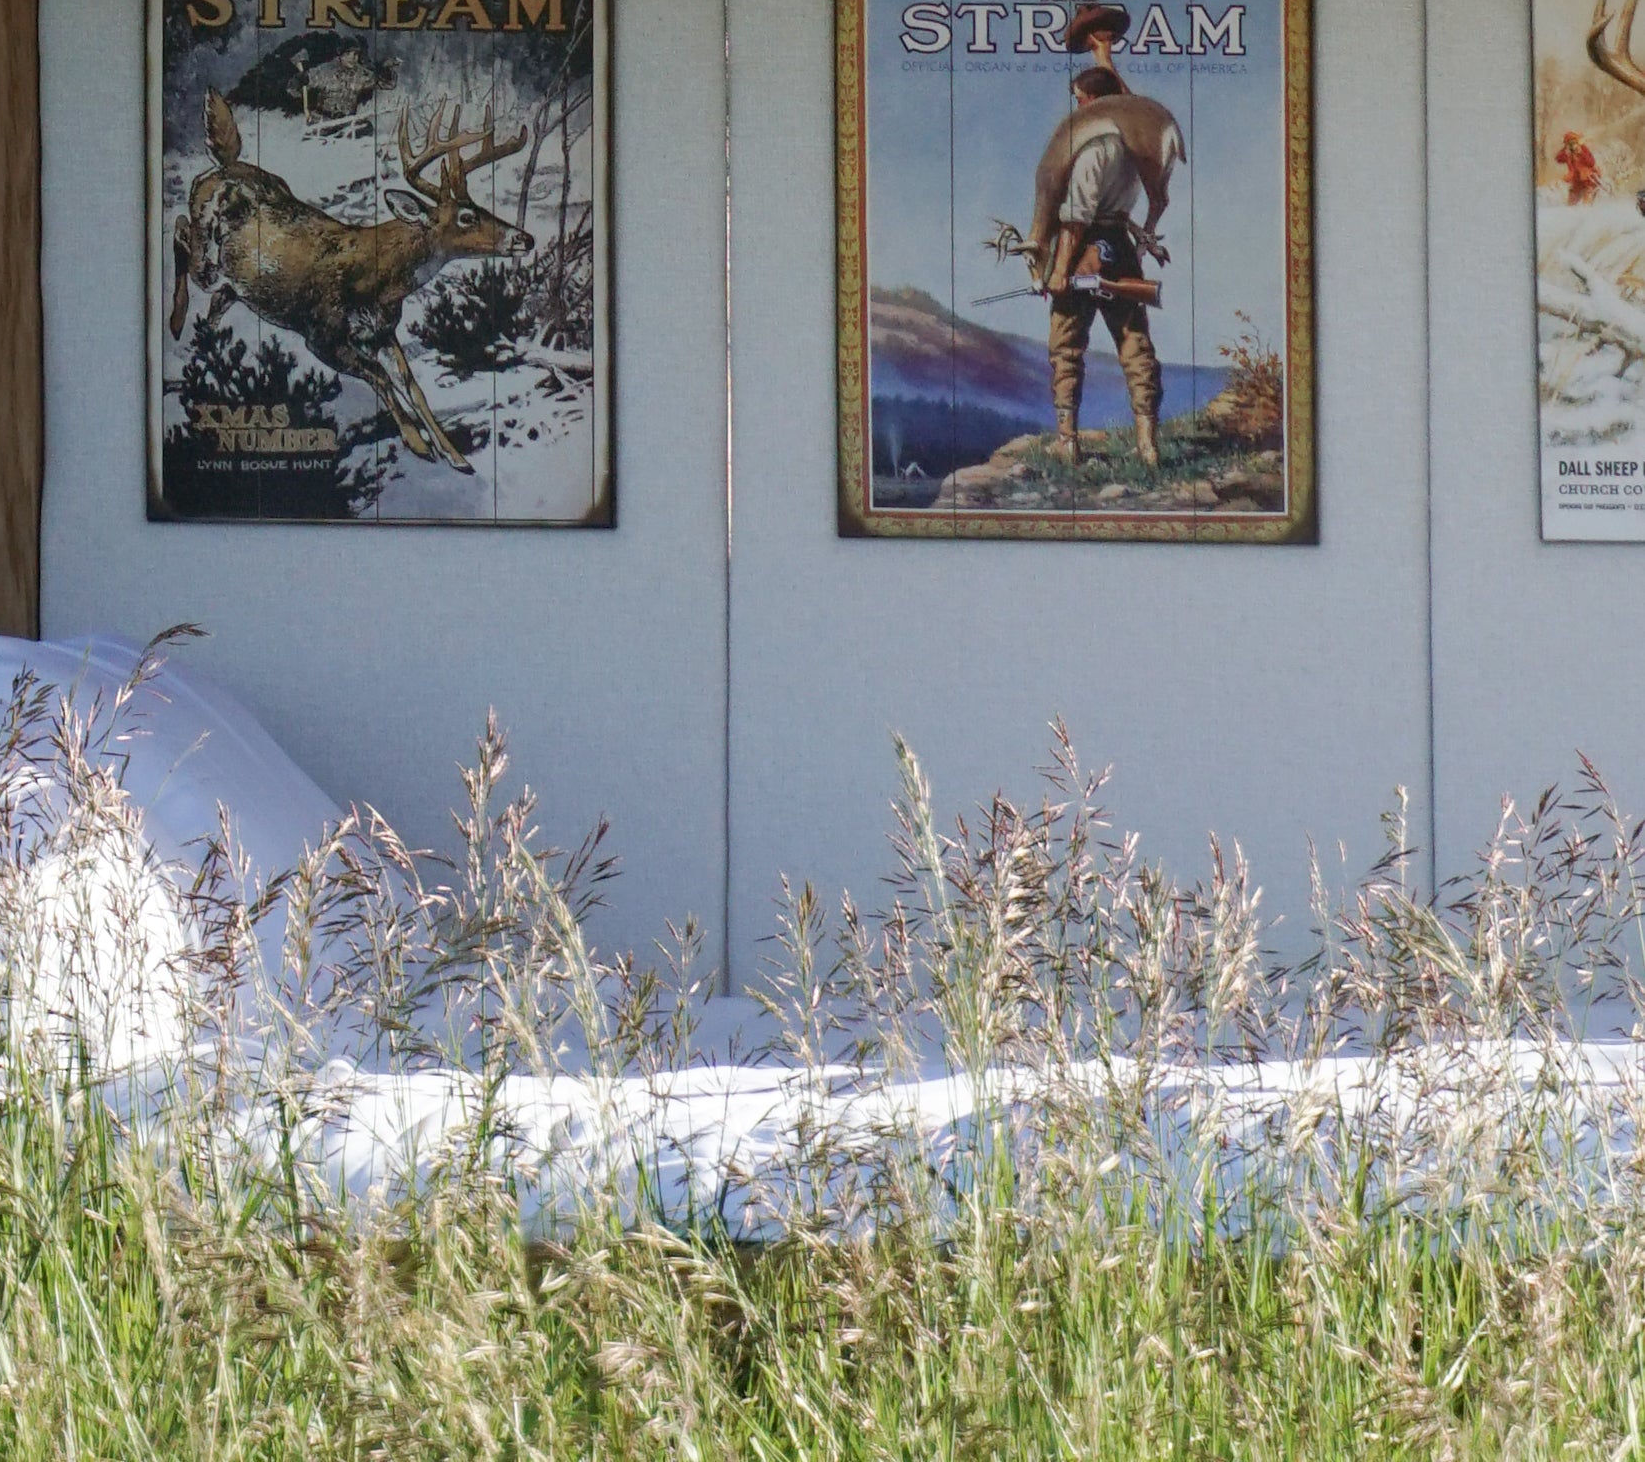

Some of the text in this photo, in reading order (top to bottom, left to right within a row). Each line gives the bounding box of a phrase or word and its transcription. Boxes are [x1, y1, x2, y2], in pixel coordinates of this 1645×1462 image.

[902, 60, 958, 73] OFFICIAL
[965, 60, 1011, 73] ORGAN
[1127, 62, 1163, 74] CLUB
[1192, 62, 1248, 75] AMERICA
[193, 403, 291, 429] XMAS
[217, 428, 340, 453] NUMBER
[197, 459, 333, 471] LYNN BOGUE HUNT
[1558, 460, 1591, 476] DALL
[1595, 460, 1638, 476] SHEEP
[1558, 484, 1645, 495] CHURCH CO
